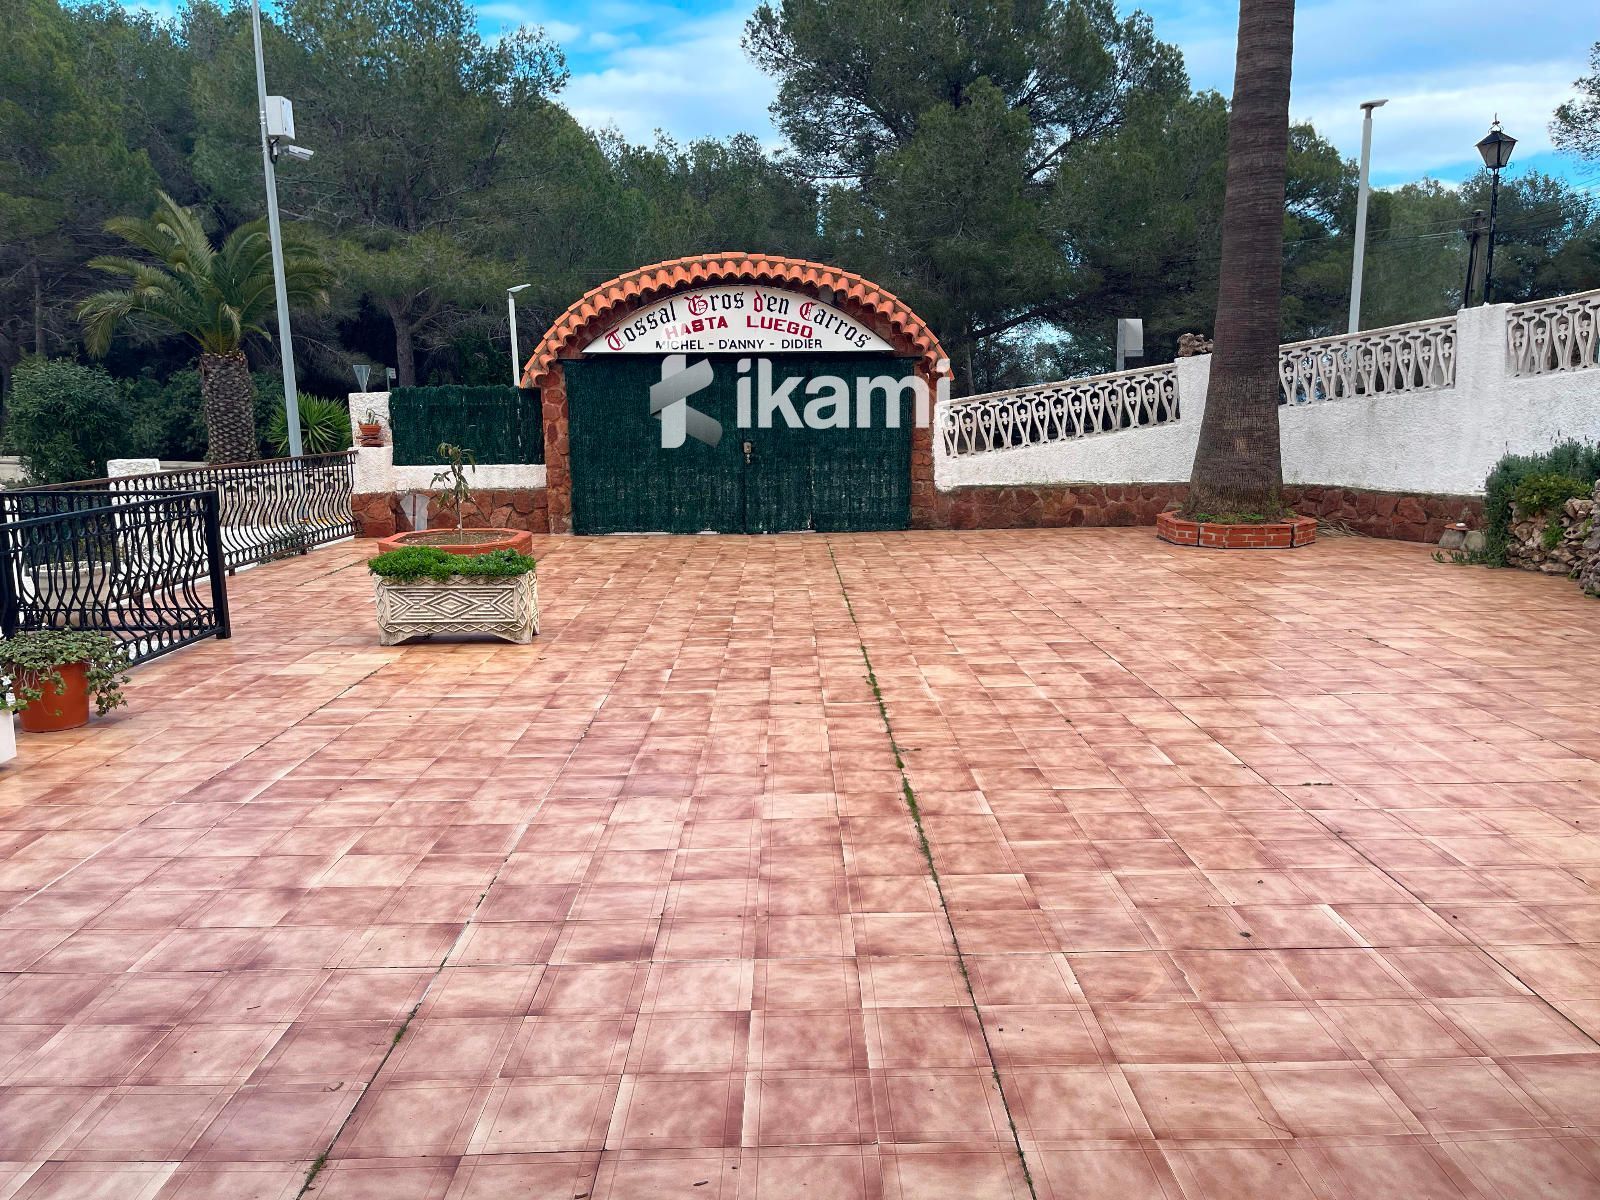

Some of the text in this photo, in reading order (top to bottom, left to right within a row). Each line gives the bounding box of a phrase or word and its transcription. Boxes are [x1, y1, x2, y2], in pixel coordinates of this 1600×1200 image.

[605, 300, 676, 351] Tossal
[684, 291, 744, 316] Gros
[799, 302, 871, 348] Carros
[665, 315, 813, 340] HASTA LUEGO
[655, 340, 704, 350] MICHEL
[781, 339, 823, 349] DIDIER
